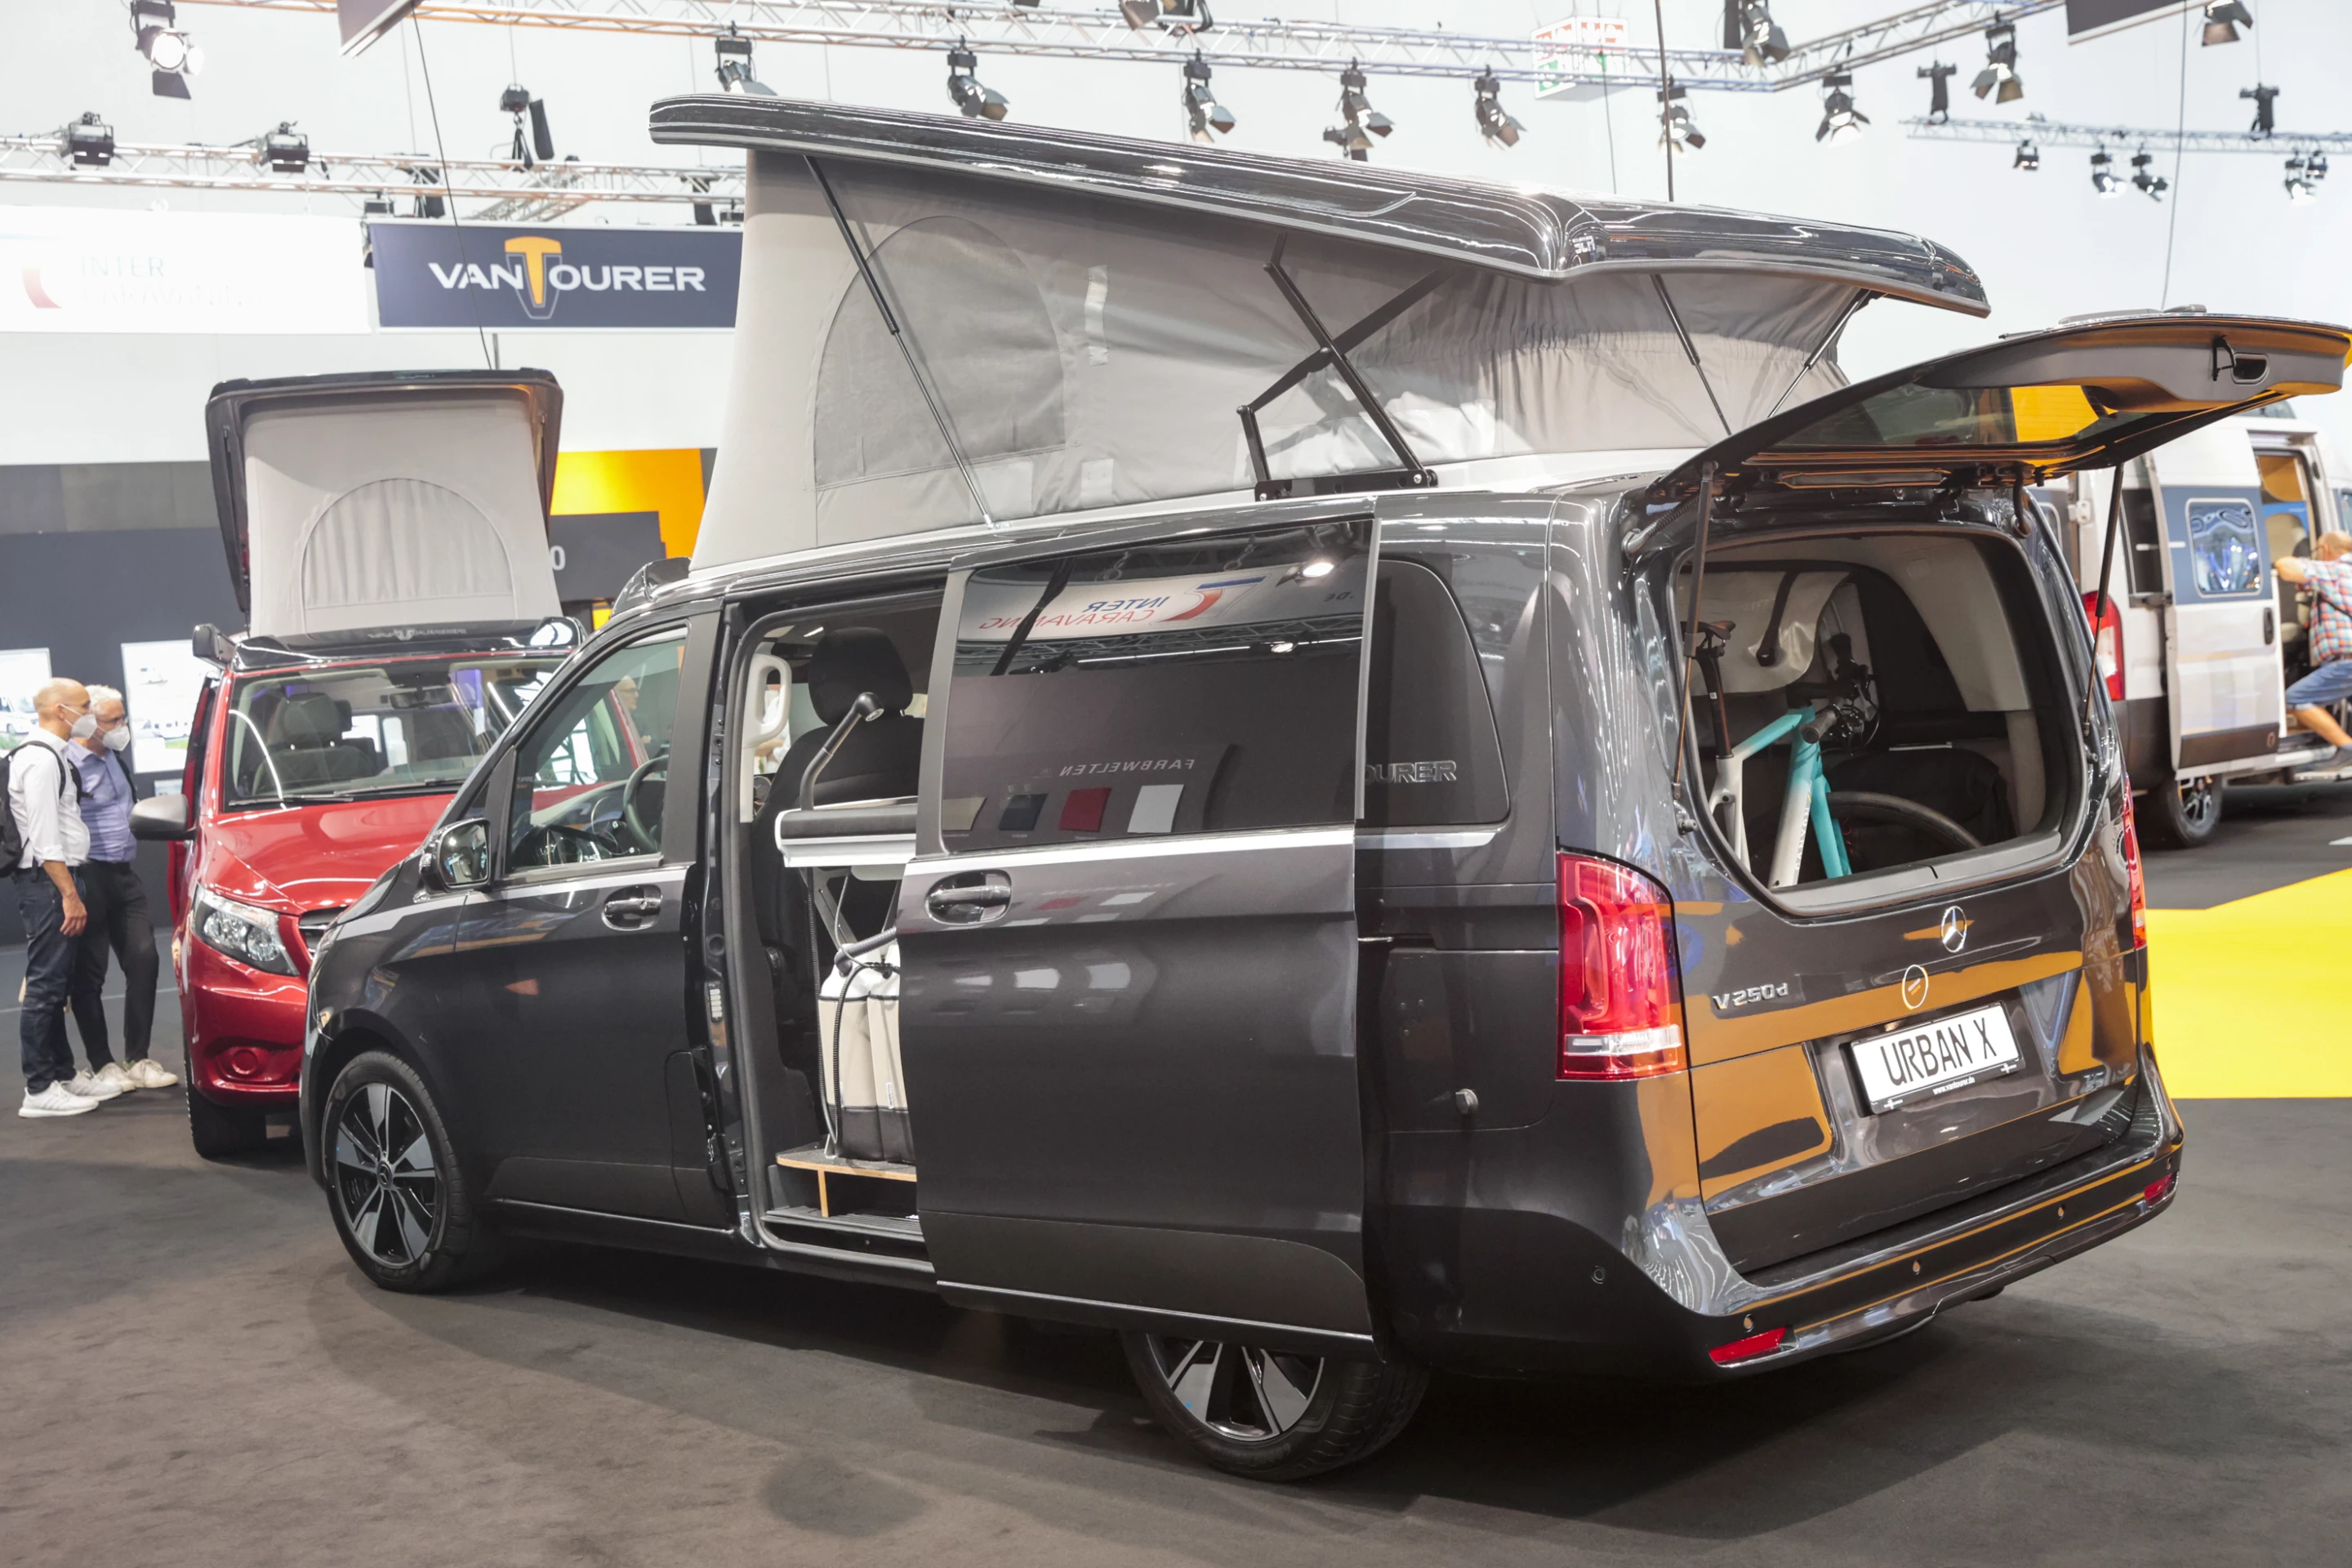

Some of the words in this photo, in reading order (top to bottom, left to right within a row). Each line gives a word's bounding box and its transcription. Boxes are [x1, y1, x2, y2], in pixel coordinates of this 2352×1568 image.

[82, 255, 164, 278] INTER
[428, 236, 706, 320] VANTOURER
[1880, 1024, 1973, 1086] URBAN
[1973, 1017, 1997, 1060] X
